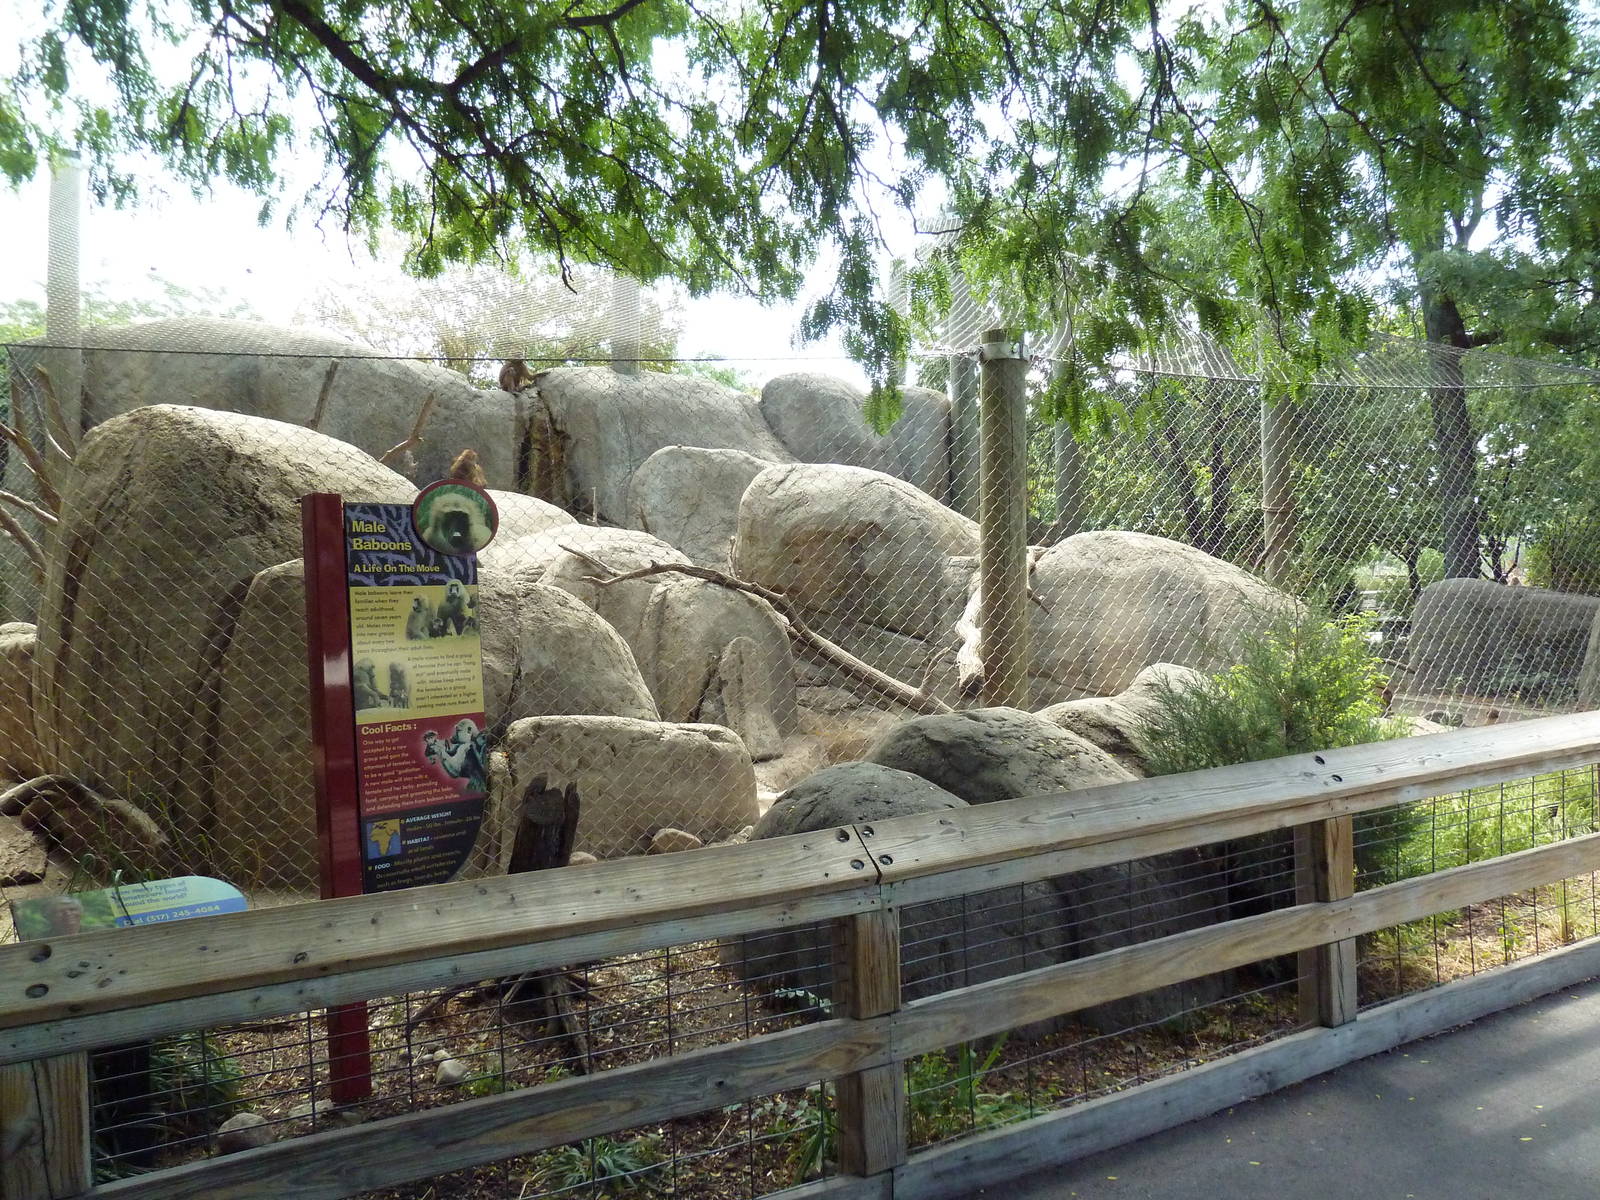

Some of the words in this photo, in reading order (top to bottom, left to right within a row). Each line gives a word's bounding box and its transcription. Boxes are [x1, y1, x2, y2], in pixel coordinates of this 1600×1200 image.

[352, 521, 386, 532] Male
[352, 538, 412, 550] Baboons
[362, 564, 382, 572] Life
[384, 564, 398, 572] On
[398, 564, 416, 572] The
[362, 724, 384, 735] Cool
[406, 814, 430, 823] AVERAGE
[432, 811, 452, 819] WEIGHT
[407, 836, 430, 845] HABITAT
[374, 862, 390, 870] FOOD
